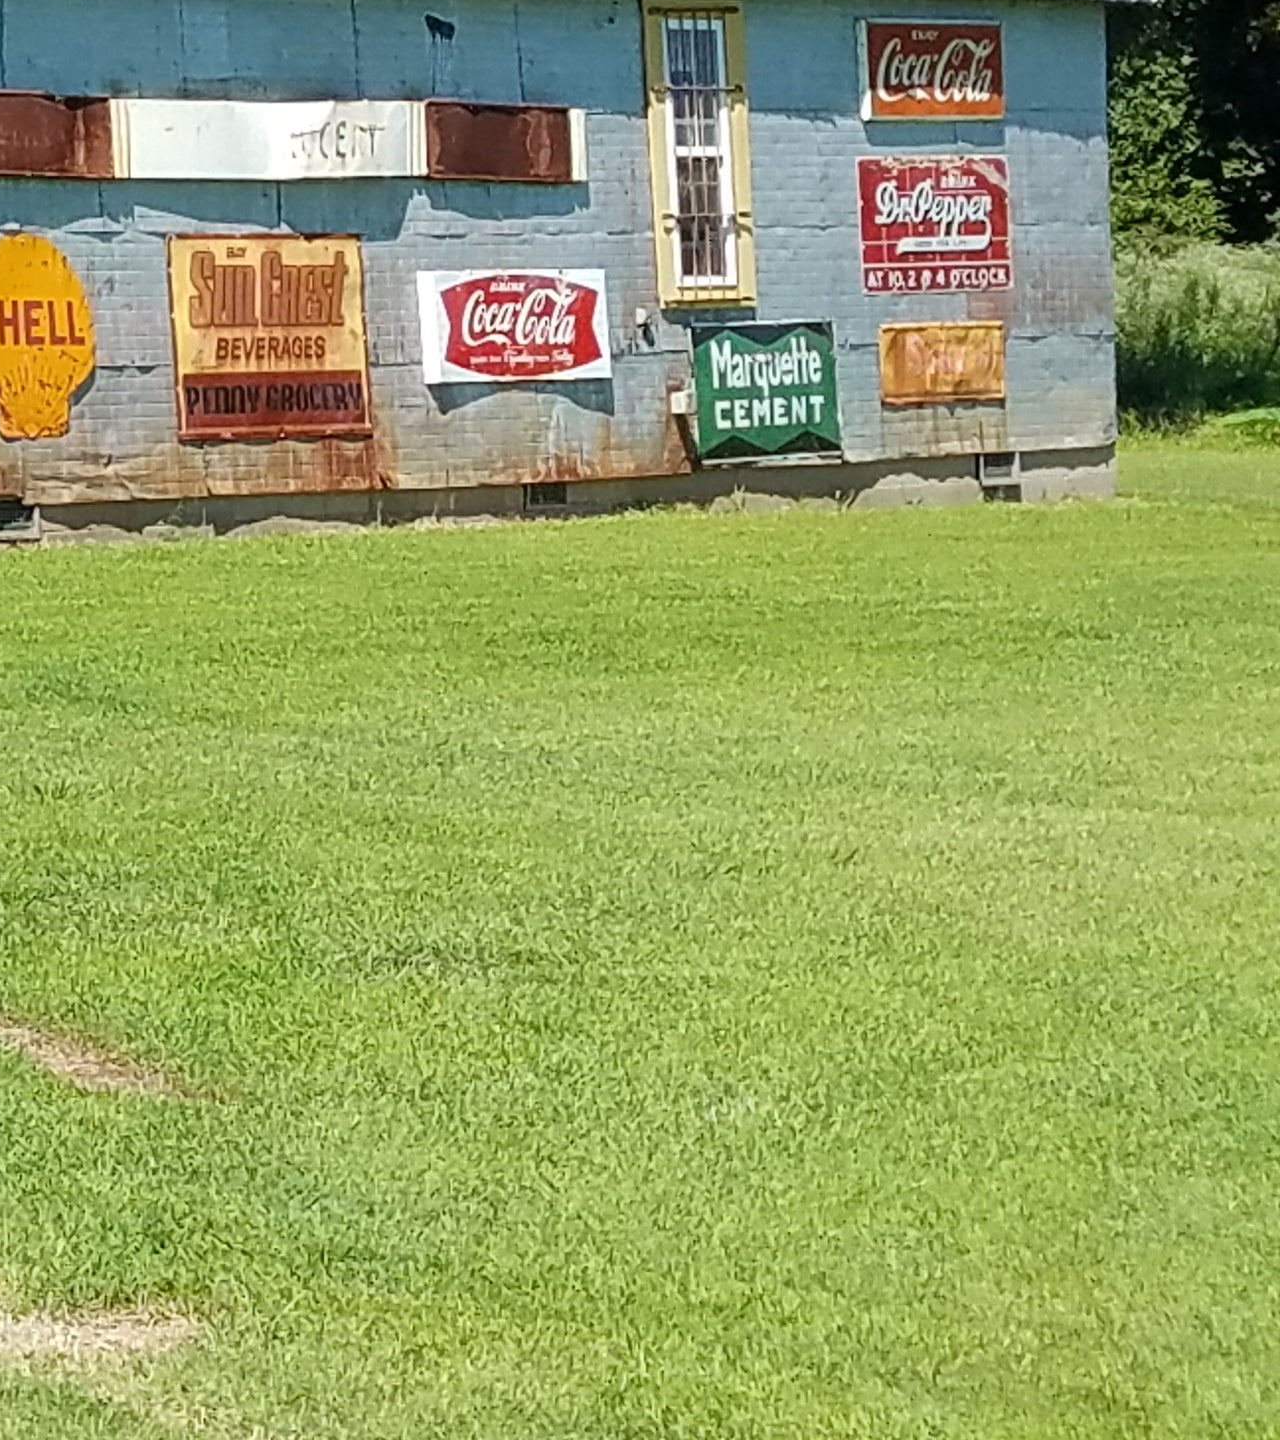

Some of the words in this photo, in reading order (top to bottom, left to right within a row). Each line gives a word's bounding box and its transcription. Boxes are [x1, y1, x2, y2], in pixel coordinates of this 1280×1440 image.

[877, 37, 995, 103] Coca-Cola
[189, 250, 260, 328] Sun
[260, 250, 349, 327] Crest
[936, 269, 946, 286] 4
[462, 289, 578, 347] Coca-Cola
[216, 335, 326, 360] BEVERAGES
[710, 336, 822, 397] Marquette
[186, 384, 261, 416] PENNY
[265, 382, 362, 413] GROCERY
[714, 395, 825, 430] CEMENT
